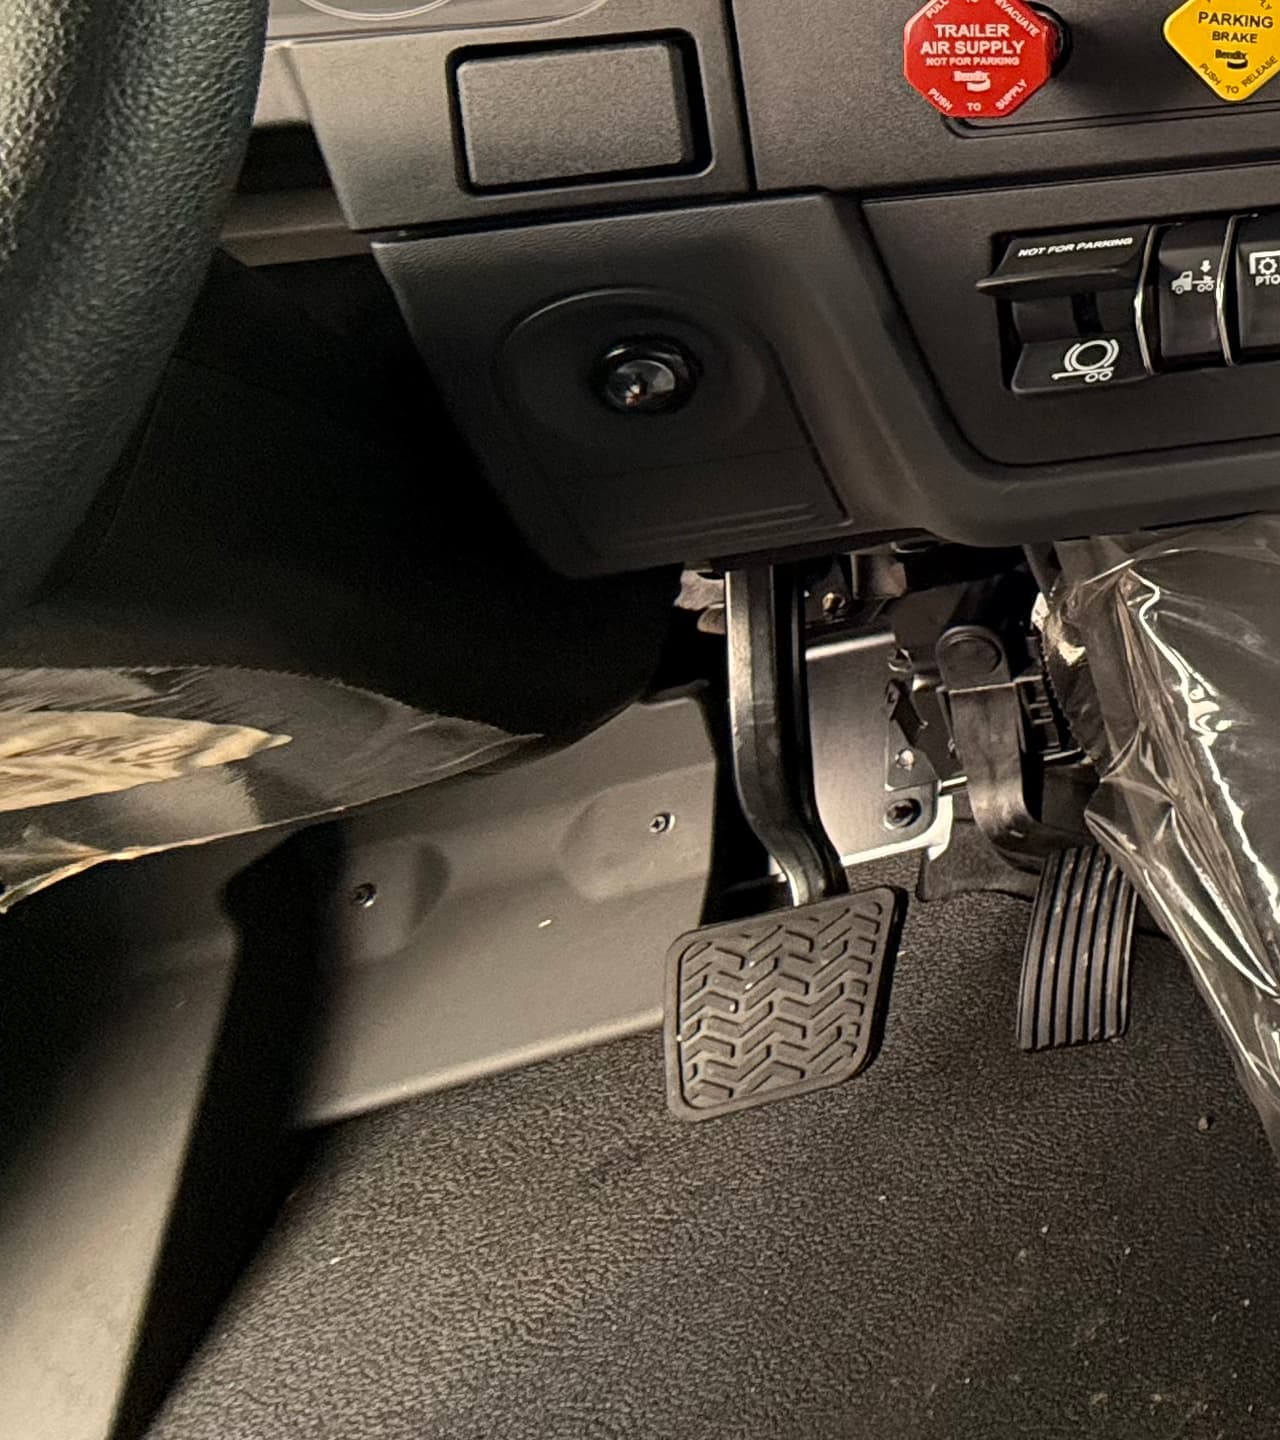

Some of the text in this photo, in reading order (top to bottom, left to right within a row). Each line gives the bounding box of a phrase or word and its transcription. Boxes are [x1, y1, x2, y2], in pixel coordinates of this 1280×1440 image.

[1198, 11, 1274, 28] PARKING
[934, 24, 1011, 37] TRAILER
[1212, 31, 1258, 44] BRAKE
[921, 40, 1025, 55] AIR SUPPLY
[1215, 49, 1247, 60] Bendix
[926, 56, 1019, 66] NOT FOR PARKING
[1199, 56, 1279, 94] PUSH TO RELEASE
[928, 80, 1027, 111] PUSH TO SUPPLY
[1017, 236, 1133, 258] NOT FOR PARKING
